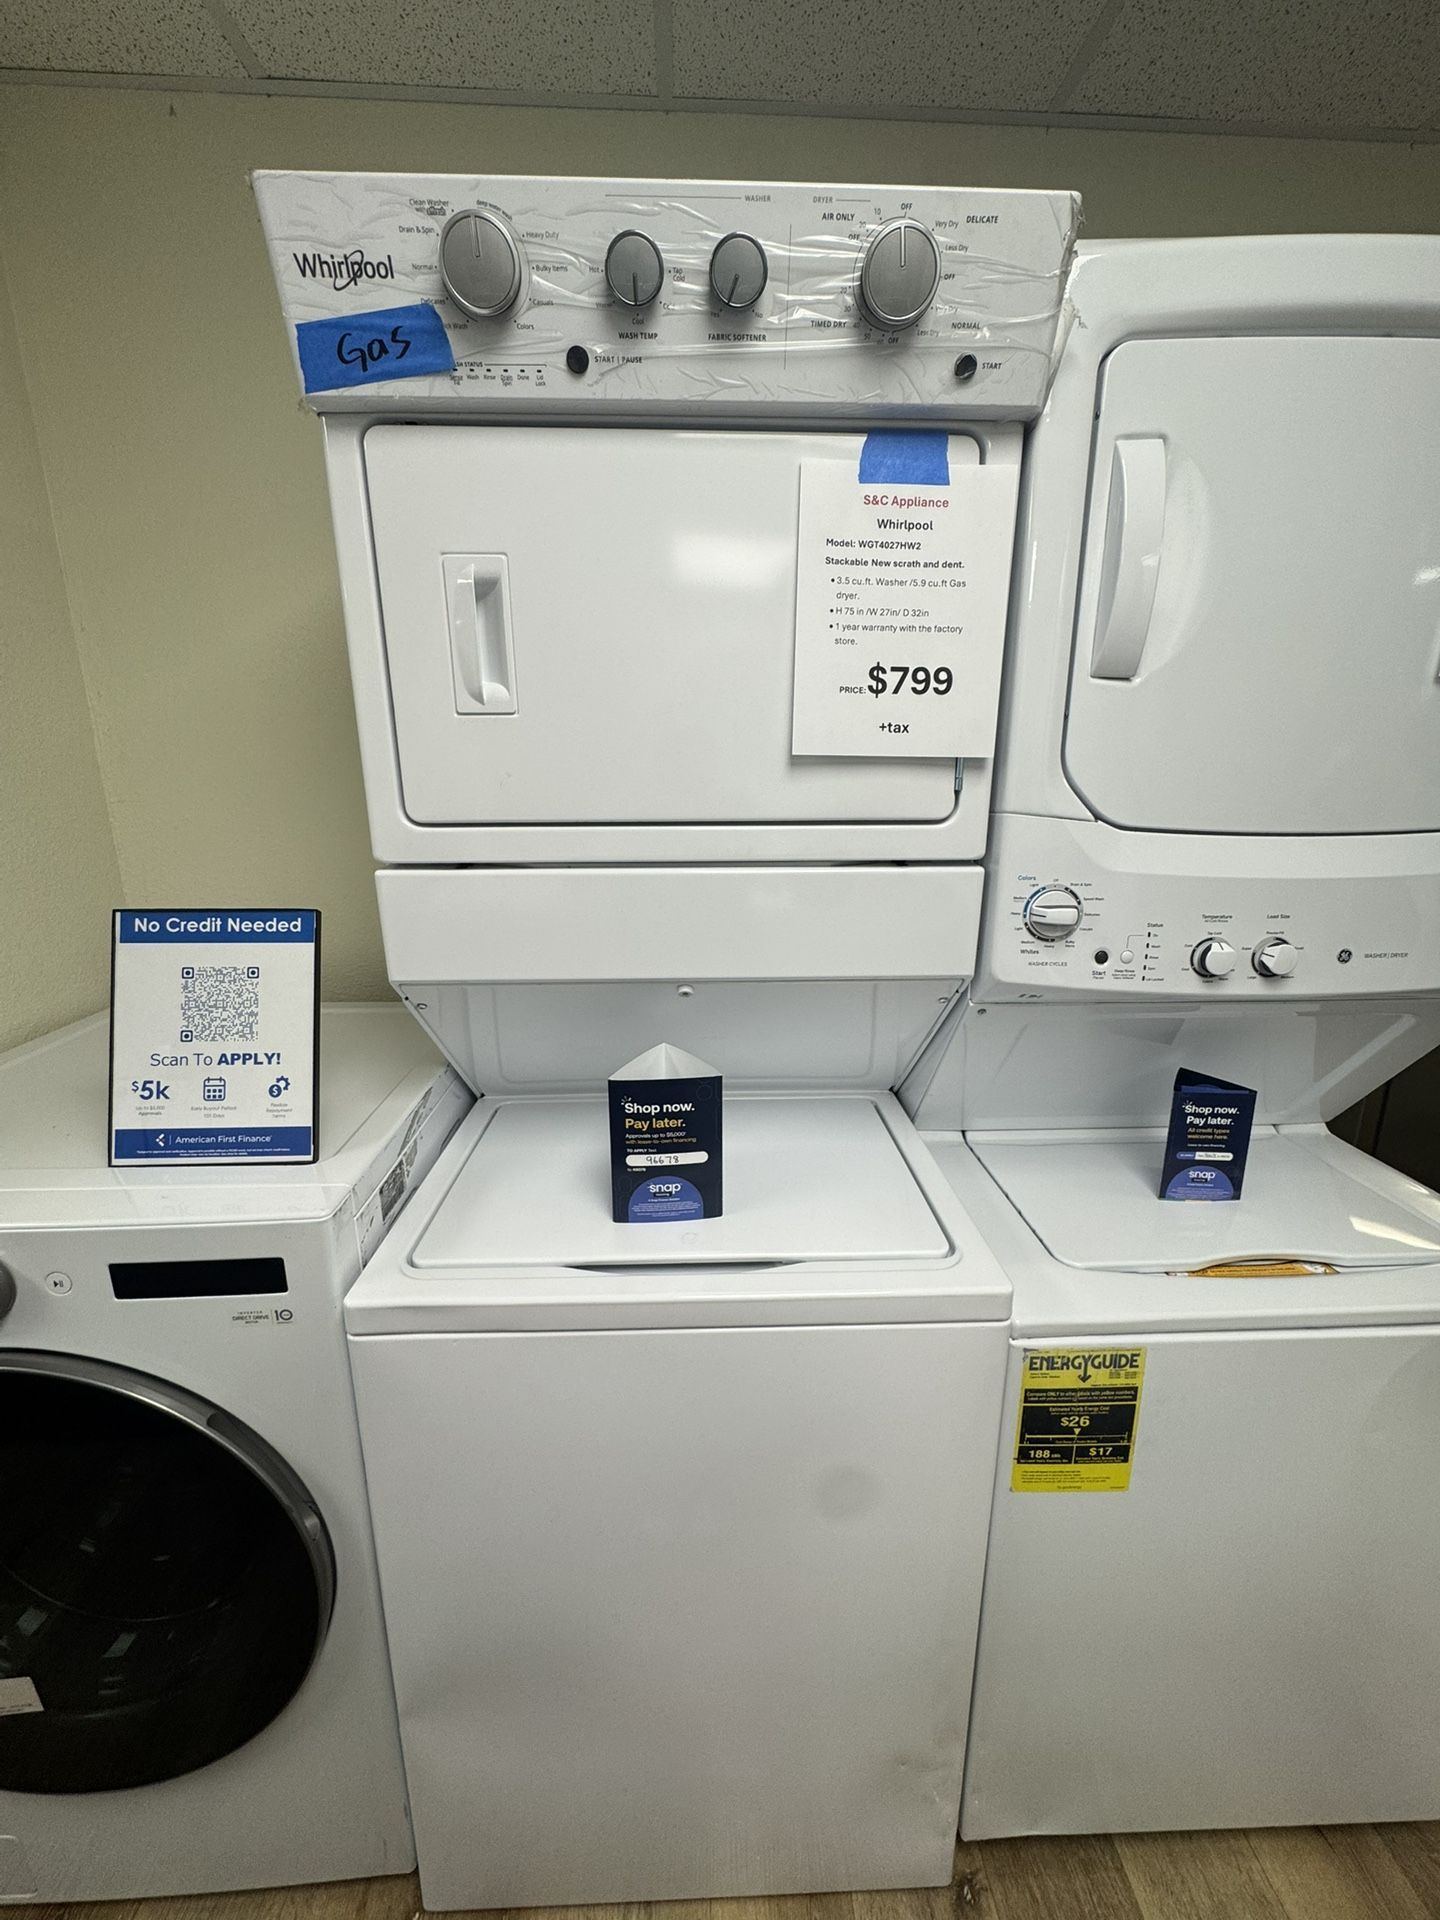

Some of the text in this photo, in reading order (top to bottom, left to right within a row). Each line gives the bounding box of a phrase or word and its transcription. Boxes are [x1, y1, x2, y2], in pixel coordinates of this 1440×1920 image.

[409, 199, 449, 207] Clean Washer
[836, 213, 855, 221] ONLY
[935, 220, 959, 229] Very Dry
[422, 227, 435, 235] Spin
[545, 231, 559, 240] Duty
[958, 244, 968, 252] Dry
[293, 250, 396, 291] Whirlpool
[536, 265, 551, 273] Bulky
[533, 299, 554, 307] Casuals
[811, 320, 831, 328] TIMED
[951, 322, 981, 330] NORMAL
[733, 334, 766, 342] SOFTENER
[337, 326, 412, 372] Gas
[622, 356, 642, 364] PAUSE
[864, 495, 949, 509] S&C Appliance
[877, 517, 934, 532] Whirlpool
[826, 538, 921, 550] Model: WGT4027HW2
[825, 557, 964, 569] Stackable New scrath and dent.
[837, 576, 850, 584] 3.5
[876, 578, 908, 586] Washer
[909, 578, 926, 587] /5.9
[928, 579, 947, 587] cu.ft
[950, 579, 966, 588] Gas
[836, 591, 860, 601] dryer.
[845, 607, 854, 615] 75
[857, 607, 864, 615] in
[866, 608, 878, 616] /W
[903, 609, 909, 617] D
[911, 609, 929, 617] 32in
[842, 624, 859, 632] year
[862, 624, 897, 633] warranty
[899, 624, 916, 632] with
[919, 624, 932, 632] the
[934, 625, 963, 634] factory
[835, 637, 857, 645] store.
[840, 660, 954, 699] PRICE: $799
[879, 722, 909, 734] +tax
[135, 918, 301, 932] No Credit Needed
[150, 1053, 281, 1066] Scan To APPLY!
[131, 1079, 171, 1101] $5k
[625, 1102, 694, 1115] Shop now.
[1184, 1103, 1239, 1115] Shop now.
[625, 1117, 685, 1131] Pay later.
[1187, 1116, 1234, 1126] Pay later.
[176, 1134, 271, 1144] American First Finance
[646, 1155, 680, 1165] 96678
[1189, 1171, 1215, 1181] snap
[649, 1183, 681, 1195] snap
[1028, 1352, 1141, 1372] ENERGYGUIDE
[1061, 1416, 1089, 1426] $26
[1029, 1450, 1050, 1458] 188
[1089, 1447, 1112, 1456] $17
